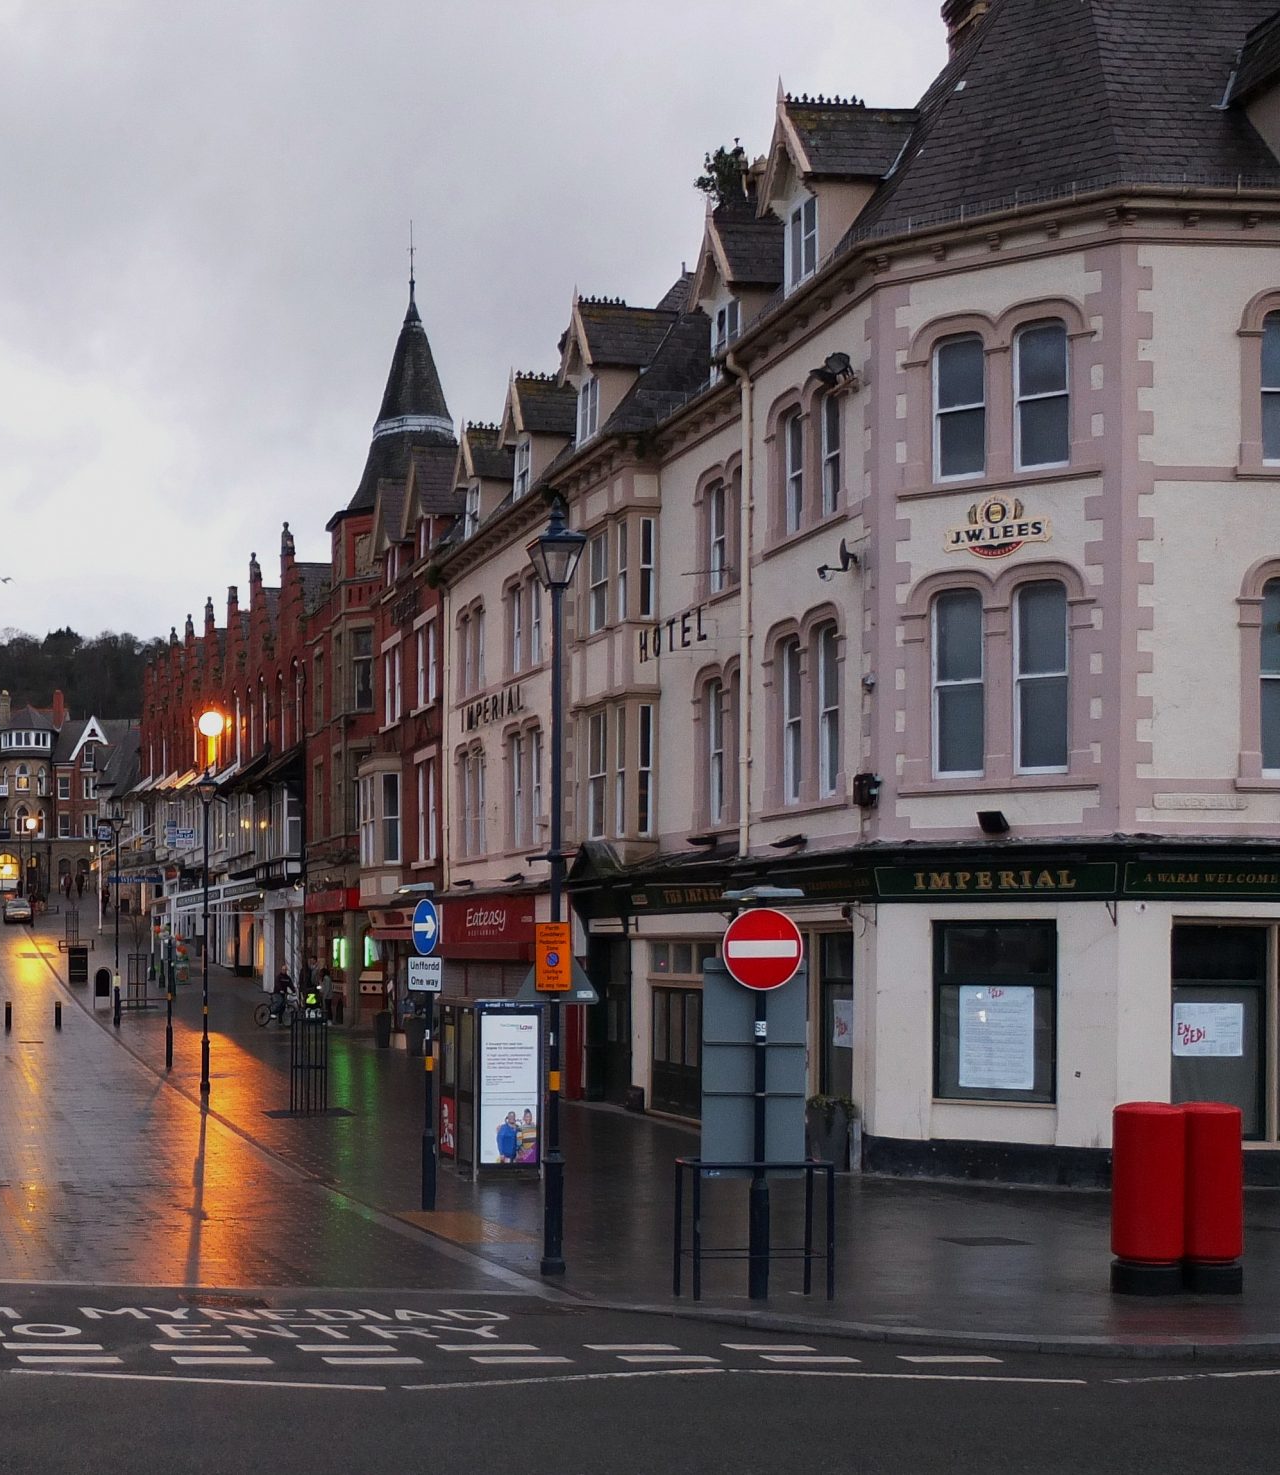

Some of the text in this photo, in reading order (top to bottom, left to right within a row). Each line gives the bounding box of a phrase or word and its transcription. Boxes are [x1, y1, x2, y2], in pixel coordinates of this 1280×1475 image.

[989, 522, 1042, 540] LEES
[638, 606, 707, 664] HOTEL
[460, 685, 524, 734] IMPERIAL
[914, 870, 1077, 890] IMPERIAL
[1143, 873, 1278, 884] A WARM WELCOME
[465, 908, 506, 932] Eateasy
[410, 961, 440, 971] Unffordd
[411, 976, 439, 988] One way
[1177, 1022, 1191, 1036] EN
[78, 1307, 511, 1322] MYNEDIAD
[157, 1322, 509, 1340] ENTRY
